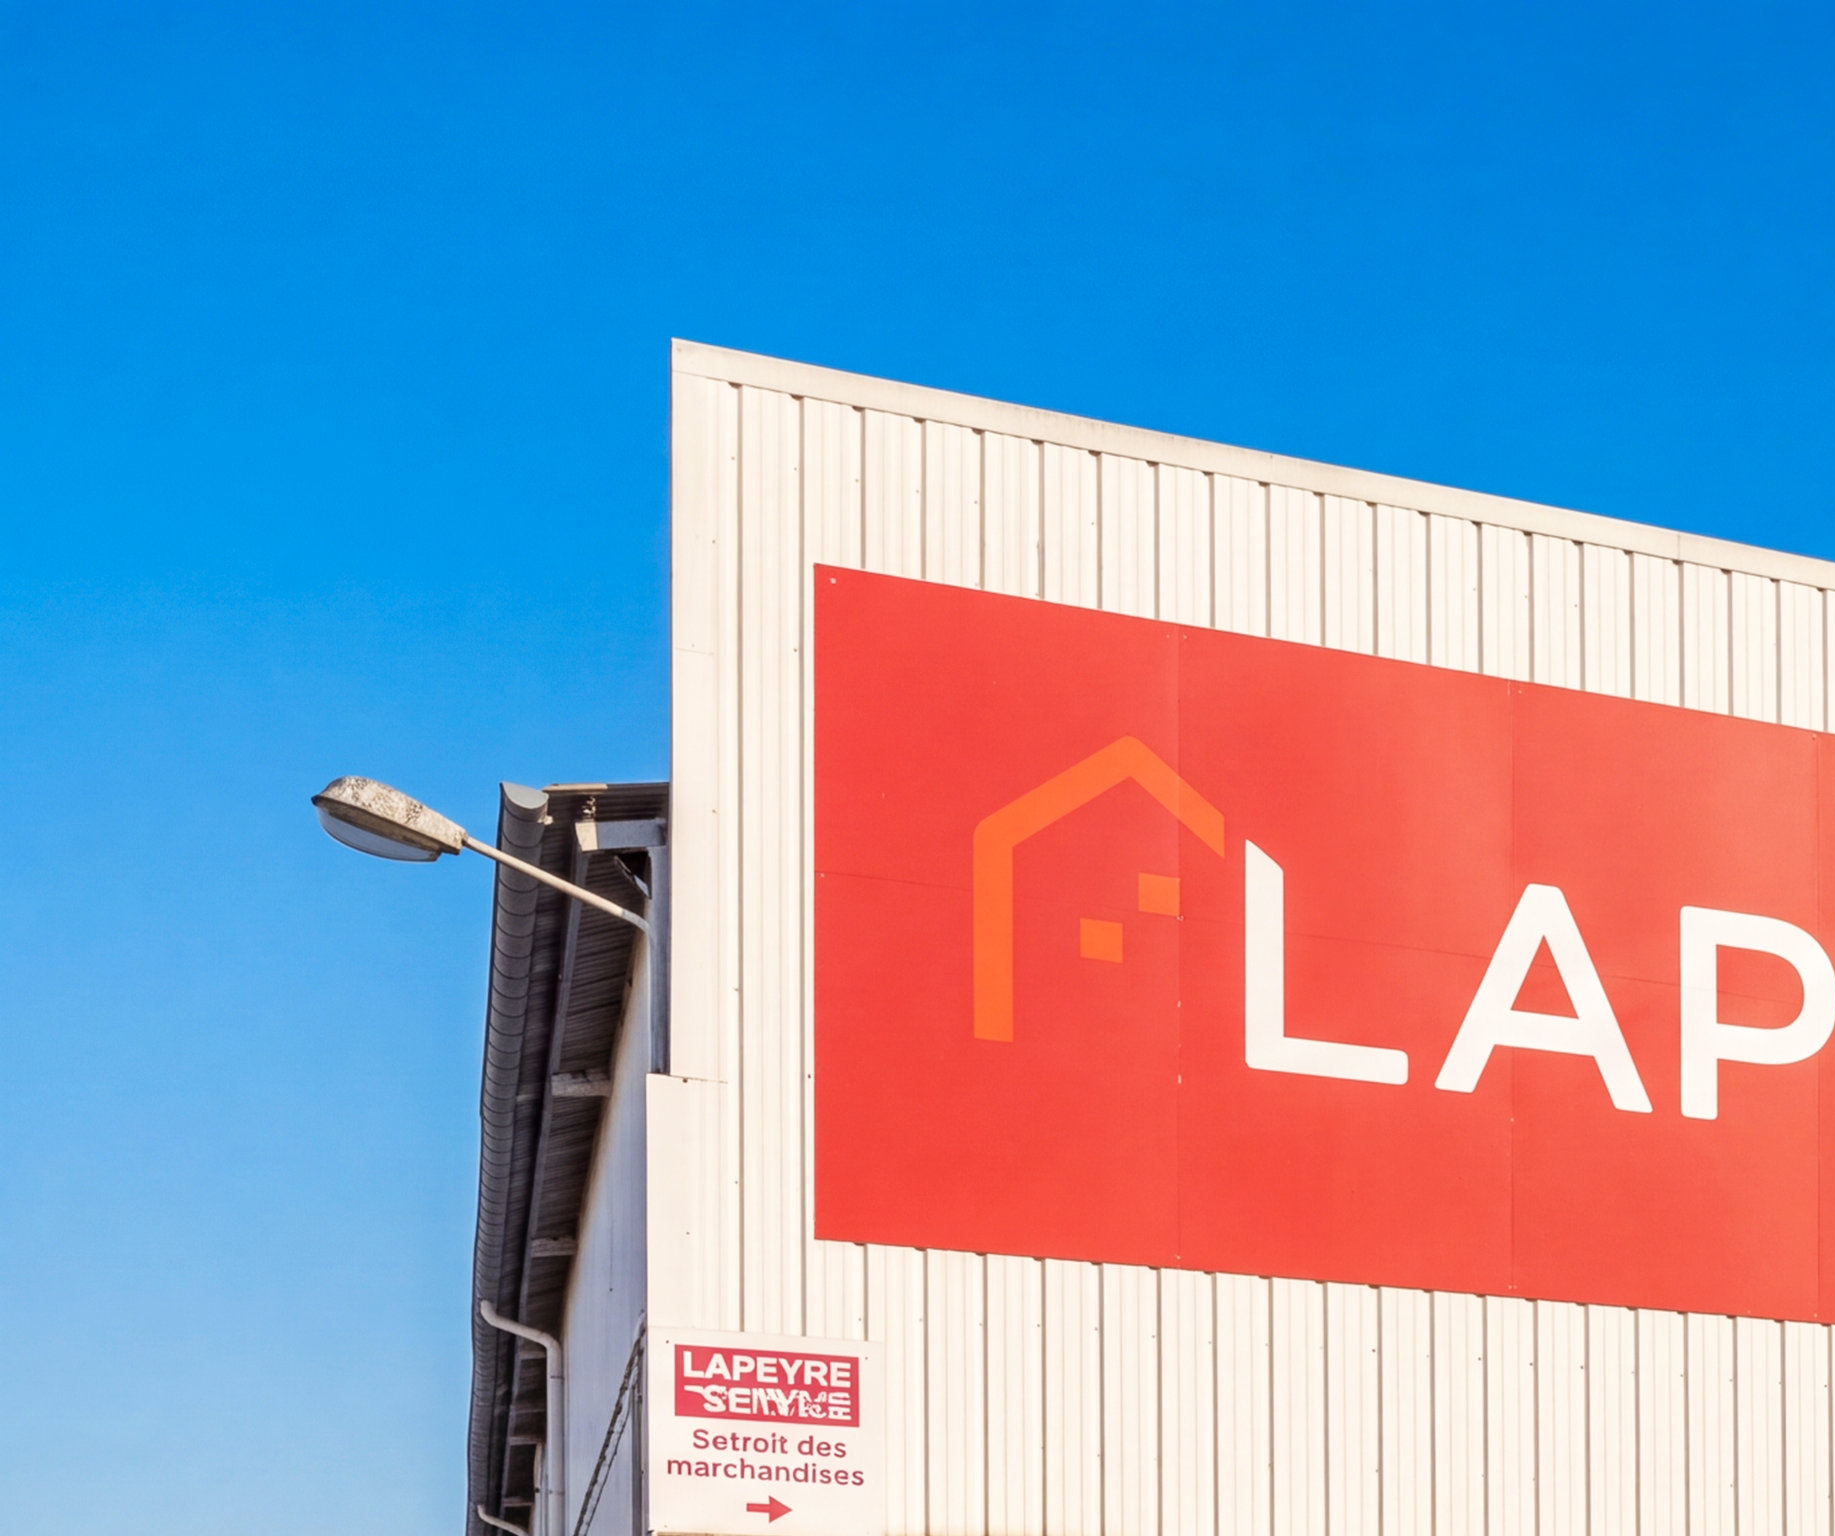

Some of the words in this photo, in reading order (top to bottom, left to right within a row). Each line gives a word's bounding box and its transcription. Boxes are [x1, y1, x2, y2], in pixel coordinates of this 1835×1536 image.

[682, 1350, 852, 1388] LAPEYRE
[692, 1428, 788, 1454] Setroit
[797, 1434, 847, 1458] des
[666, 1457, 865, 1487] marchandises
